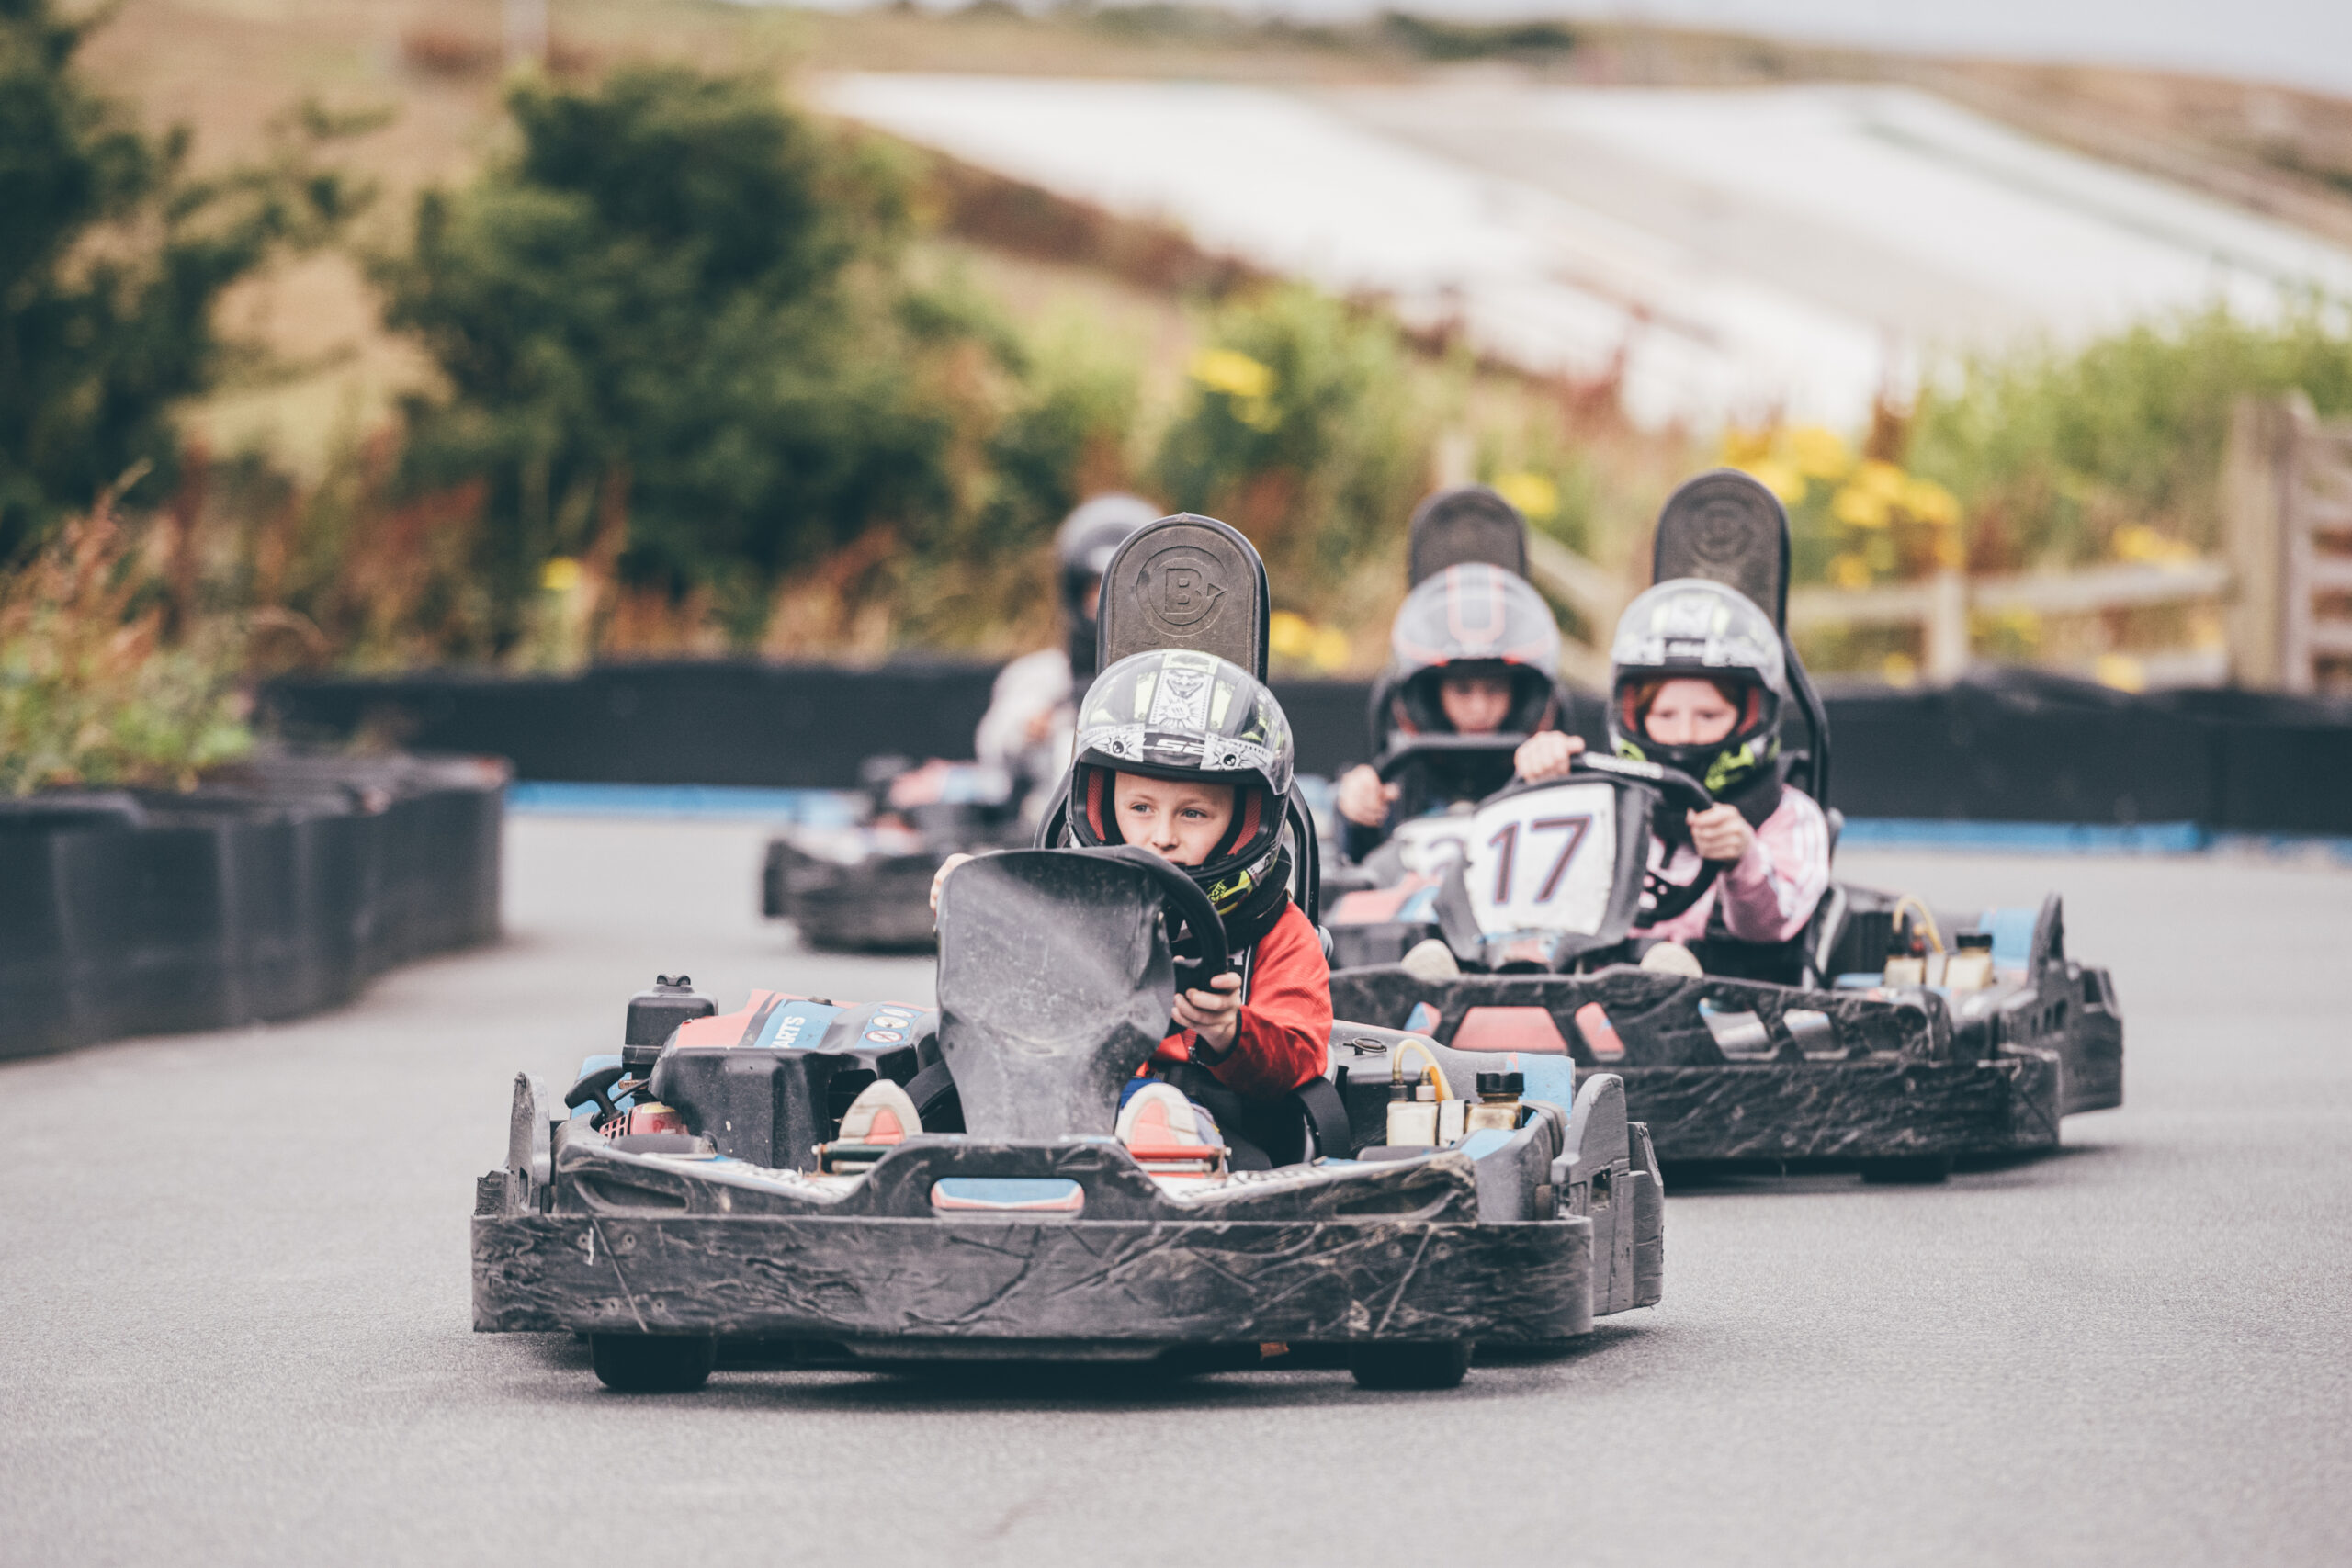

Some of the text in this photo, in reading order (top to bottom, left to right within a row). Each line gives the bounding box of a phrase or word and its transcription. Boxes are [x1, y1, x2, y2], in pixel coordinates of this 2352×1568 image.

[1164, 568, 1202, 614] B
[1487, 813, 1593, 904] 17
[770, 1015, 806, 1048] ARTS
